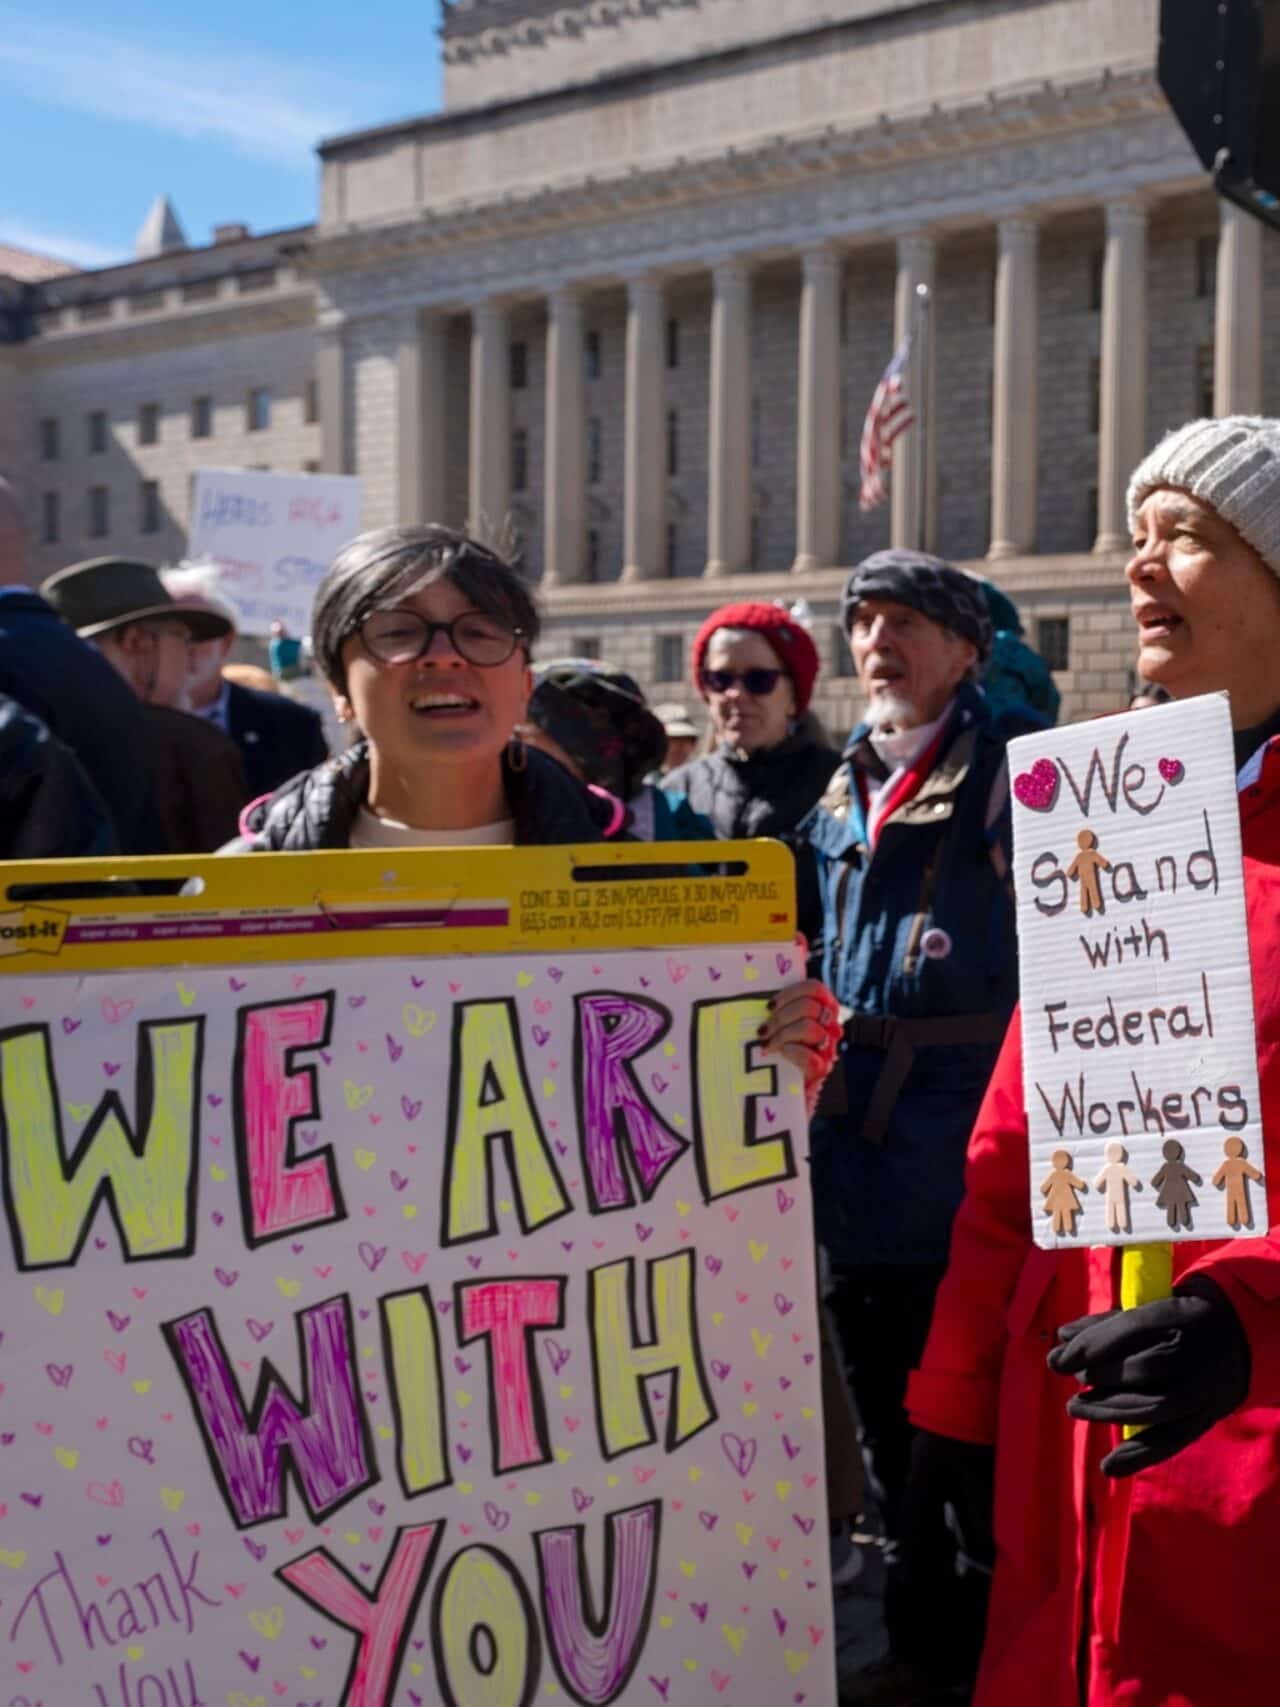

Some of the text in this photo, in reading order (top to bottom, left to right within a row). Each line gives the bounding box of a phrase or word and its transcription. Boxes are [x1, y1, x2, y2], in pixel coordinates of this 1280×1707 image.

[1055, 730, 1166, 818] We
[1030, 807, 1219, 918] Sand
[0, 919, 59, 939] ost-it
[1079, 918, 1169, 970] with
[1043, 970, 1214, 1053] Federal
[0, 989, 799, 1270] WE ARE
[1034, 1070, 1249, 1137] Workers
[160, 1246, 719, 1530] WITH
[9, 1527, 222, 1666] Thank
[273, 1498, 663, 1707] YOU
